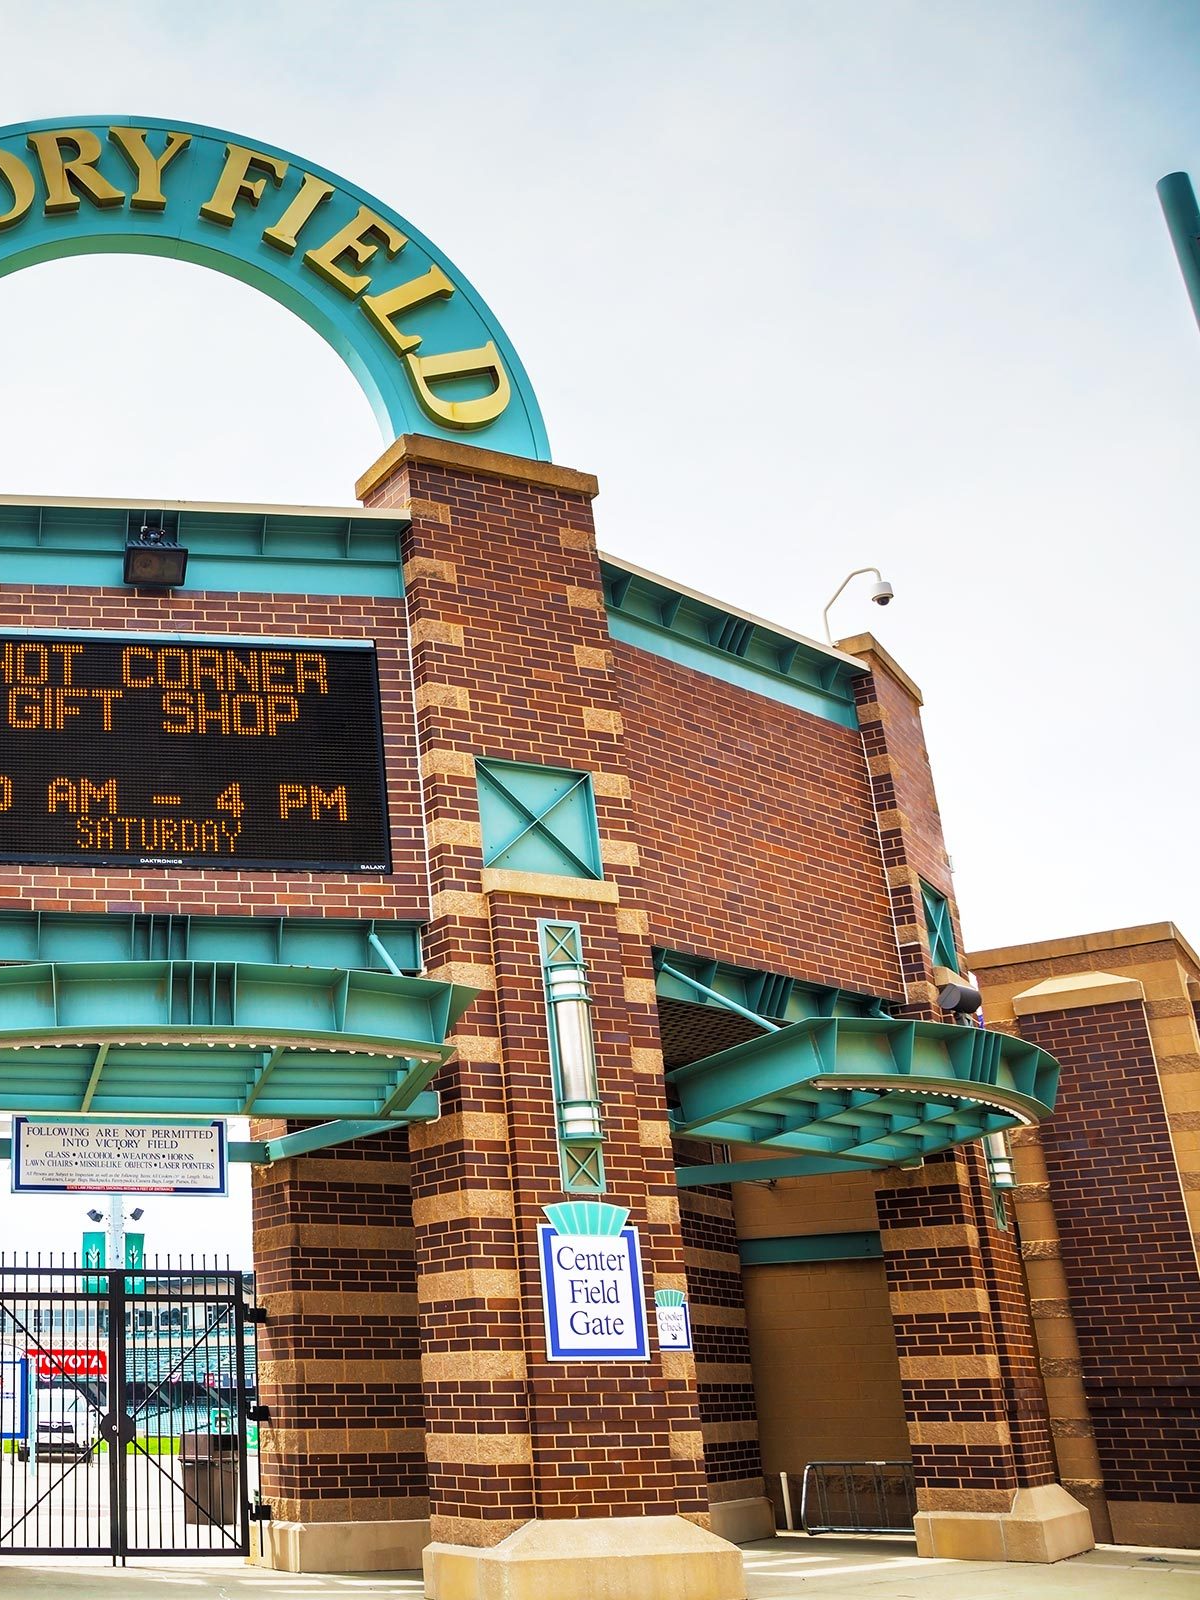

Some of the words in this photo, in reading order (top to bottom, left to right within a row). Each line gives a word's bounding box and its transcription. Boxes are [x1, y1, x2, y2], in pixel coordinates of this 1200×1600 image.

[200, 141, 512, 432] FIELD
[122, 646, 329, 694] CORNER
[8, 687, 123, 731] GIFT
[162, 691, 299, 736] SHOP
[48, 777, 118, 814] AM
[216, 782, 245, 818] 4
[279, 784, 348, 821] PM
[76, 816, 244, 853] SATURDAY
[27, 1127, 90, 1137] FOLLOWING
[95, 1128, 119, 1138] ARE
[125, 1128, 147, 1138] NOT
[152, 1129, 214, 1139] PERMITTED
[62, 1138, 90, 1147] INTO
[95, 1139, 141, 1149] VICTORY
[147, 1140, 179, 1149] FIELD
[25, 1159, 46, 1167] LAWN
[47, 1160, 74, 1168] CHAIRS
[124, 1161, 153, 1169] OBJECTS
[158, 1161, 180, 1170] LASER
[181, 1162, 215, 1170] POINTERS
[44, 1151, 71, 1159] GLASS
[77, 1151, 115, 1160] ALCOHOL
[121, 1152, 161, 1160] WEAPONS
[167, 1152, 194, 1161] HORNS
[556, 1246, 625, 1272] Center
[568, 1279, 620, 1304] Field
[569, 1310, 624, 1336] Gate
[36, 1354, 103, 1369] TOYOTA
